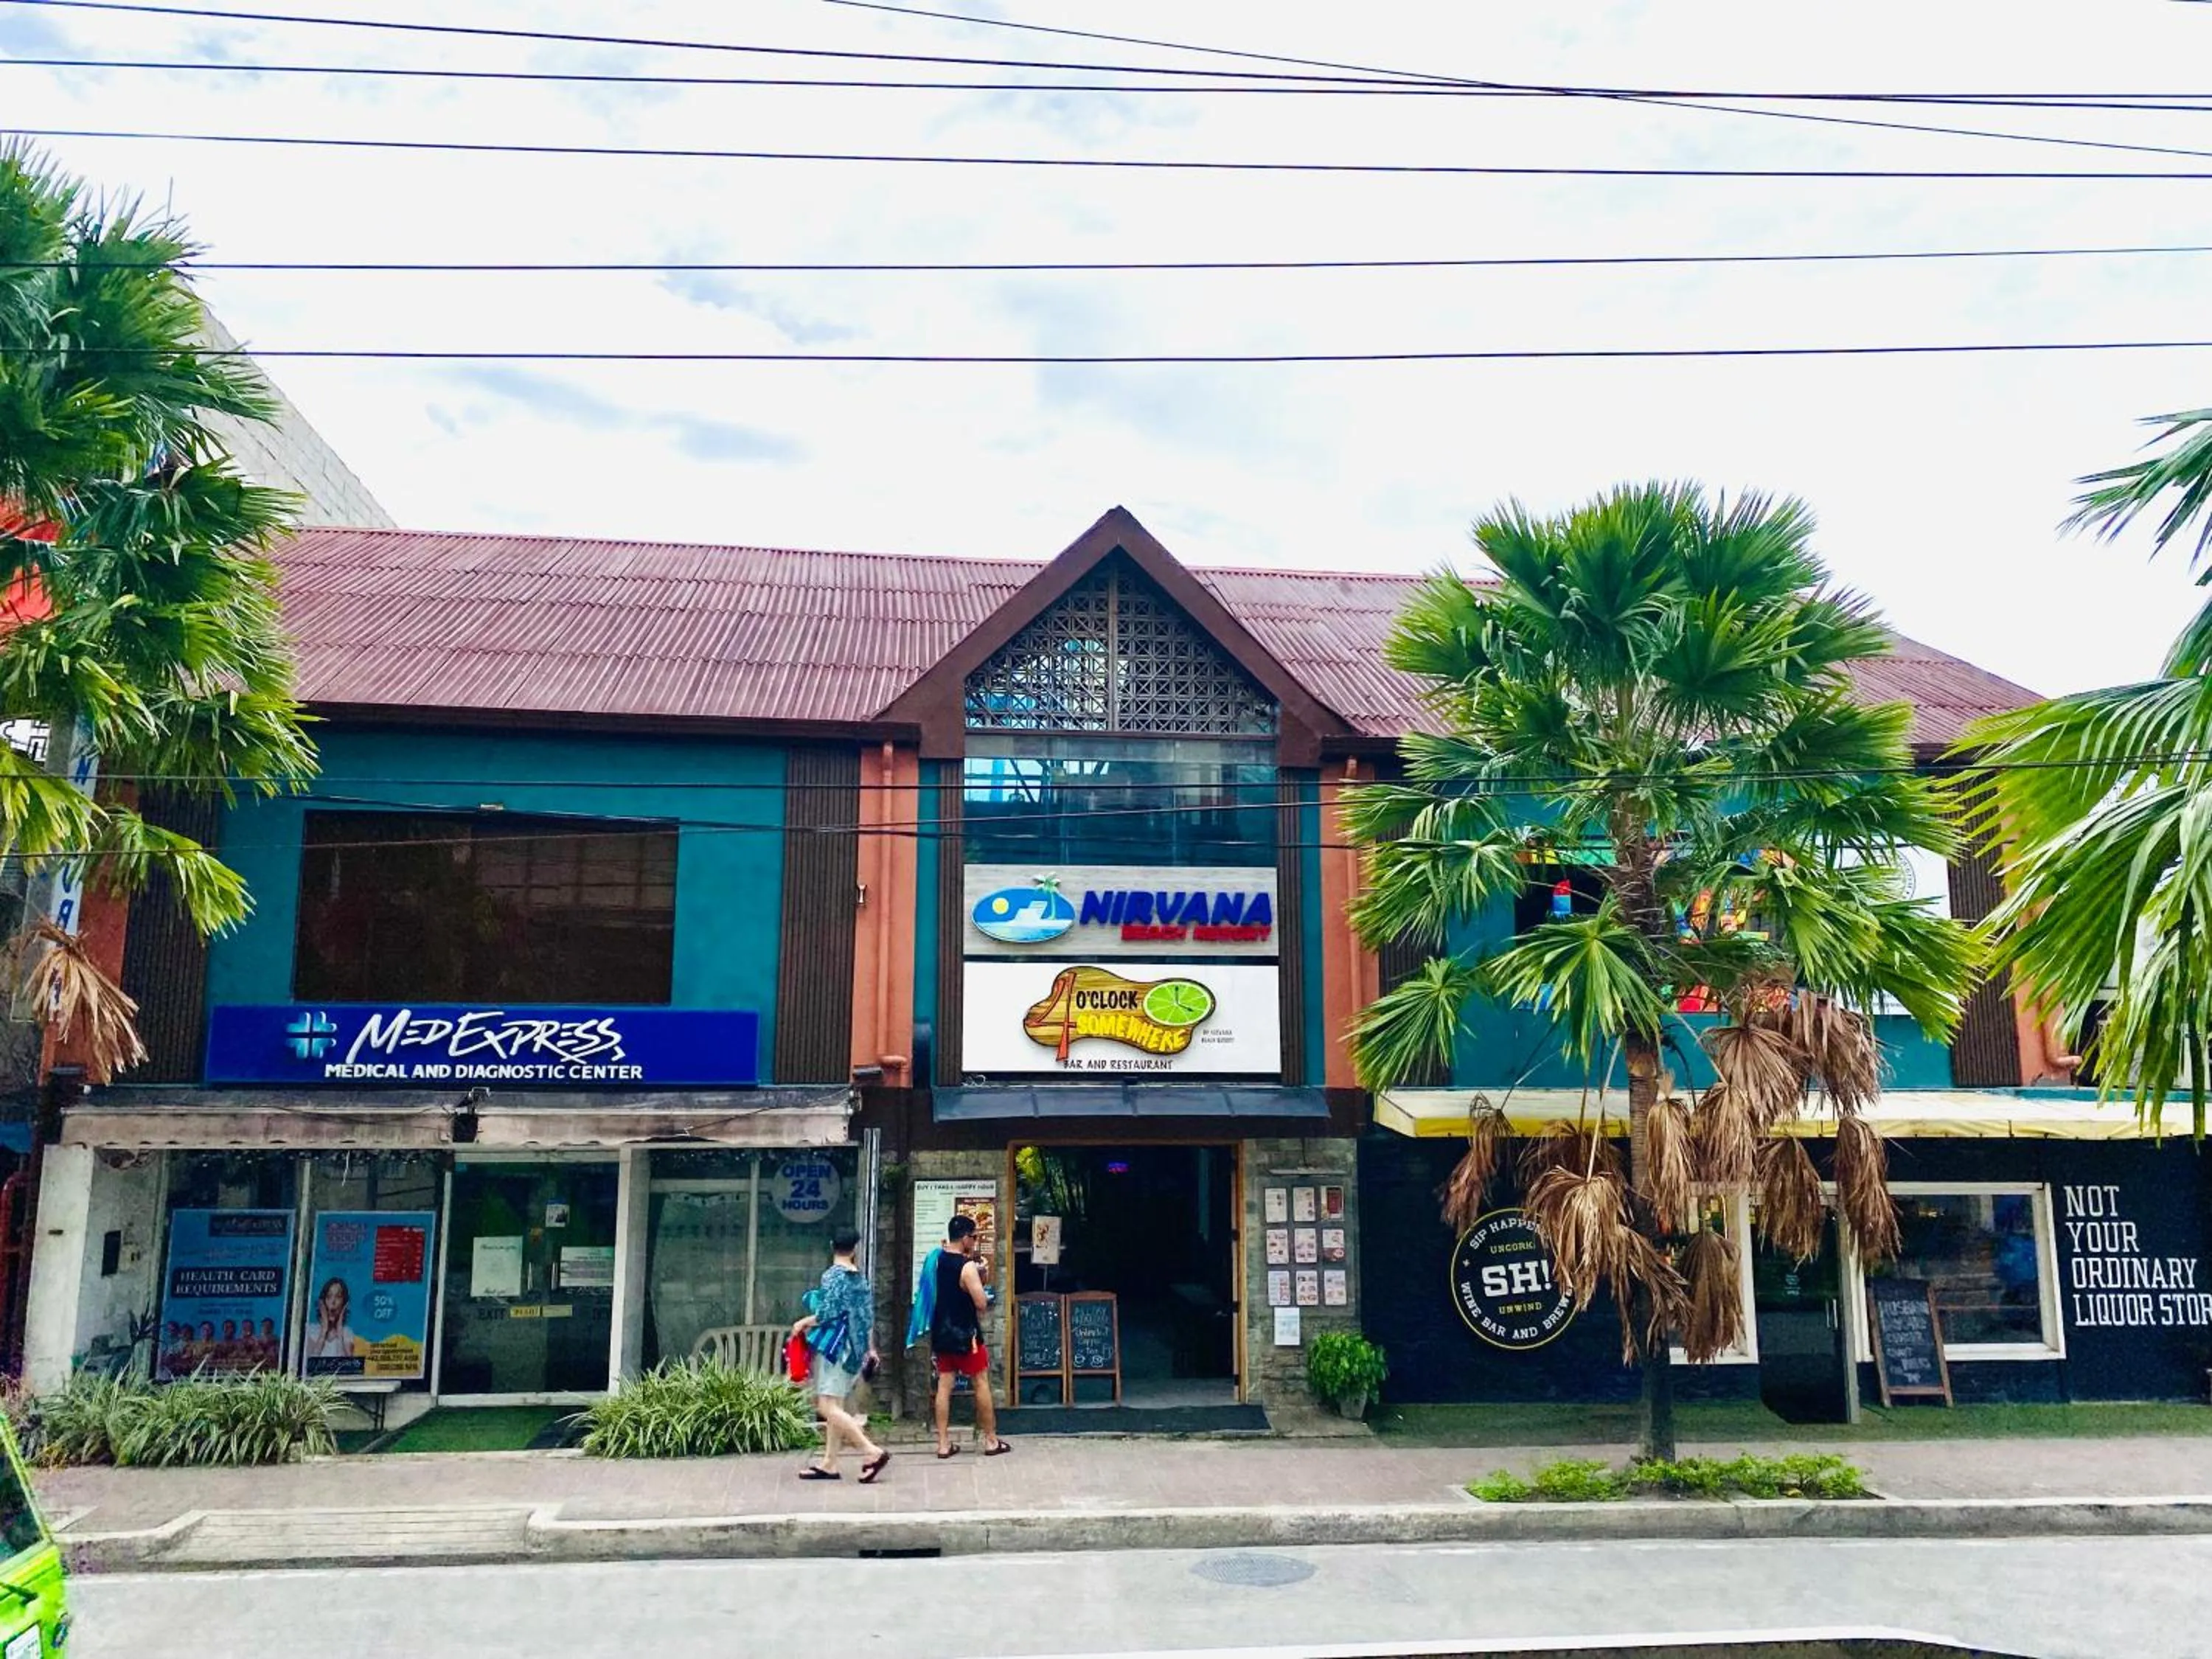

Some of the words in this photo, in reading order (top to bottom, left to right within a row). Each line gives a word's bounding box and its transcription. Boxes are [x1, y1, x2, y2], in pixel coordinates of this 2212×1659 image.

[1079, 891, 1273, 926] NIRVANA
[1076, 990, 1139, 1010] O'CLOCK
[1028, 972, 1077, 1062] 4
[1076, 1013, 1187, 1053] SOMEWHERE
[324, 1063, 408, 1079] MEDICAL
[411, 1063, 452, 1079] AND
[455, 1064, 566, 1079] DIAGNOSTIC
[568, 1064, 643, 1080] CENTER
[1063, 1059, 1083, 1070] BAR
[1087, 1059, 1107, 1070] AND
[1110, 1059, 1174, 1070] RESTAURANT
[782, 1164, 832, 1179] OPEN
[790, 1180, 822, 1199] 24
[782, 1199, 830, 1211] HOURS
[2063, 1185, 2120, 1217] NOT
[1470, 1229, 1488, 1250] SIP
[2065, 1221, 2140, 1253] YOUR
[1490, 1241, 1534, 1254] UNCORK
[180, 1270, 234, 1281] HEALTH
[240, 1270, 276, 1281] CARD
[1481, 1259, 1552, 1298] SH!
[2071, 1257, 2197, 1289] ORDINARY
[175, 1283, 277, 1296] REQUIREMENTS
[374, 1308, 394, 1319] OFF
[1461, 1281, 1482, 1318] WINE
[1481, 1317, 1506, 1338] BAR
[1512, 1326, 1539, 1340] AND
[1498, 1301, 1543, 1315] UNWIND
[2073, 1294, 2156, 1326] LIQUOR
[2159, 1293, 2212, 1326] STOR
